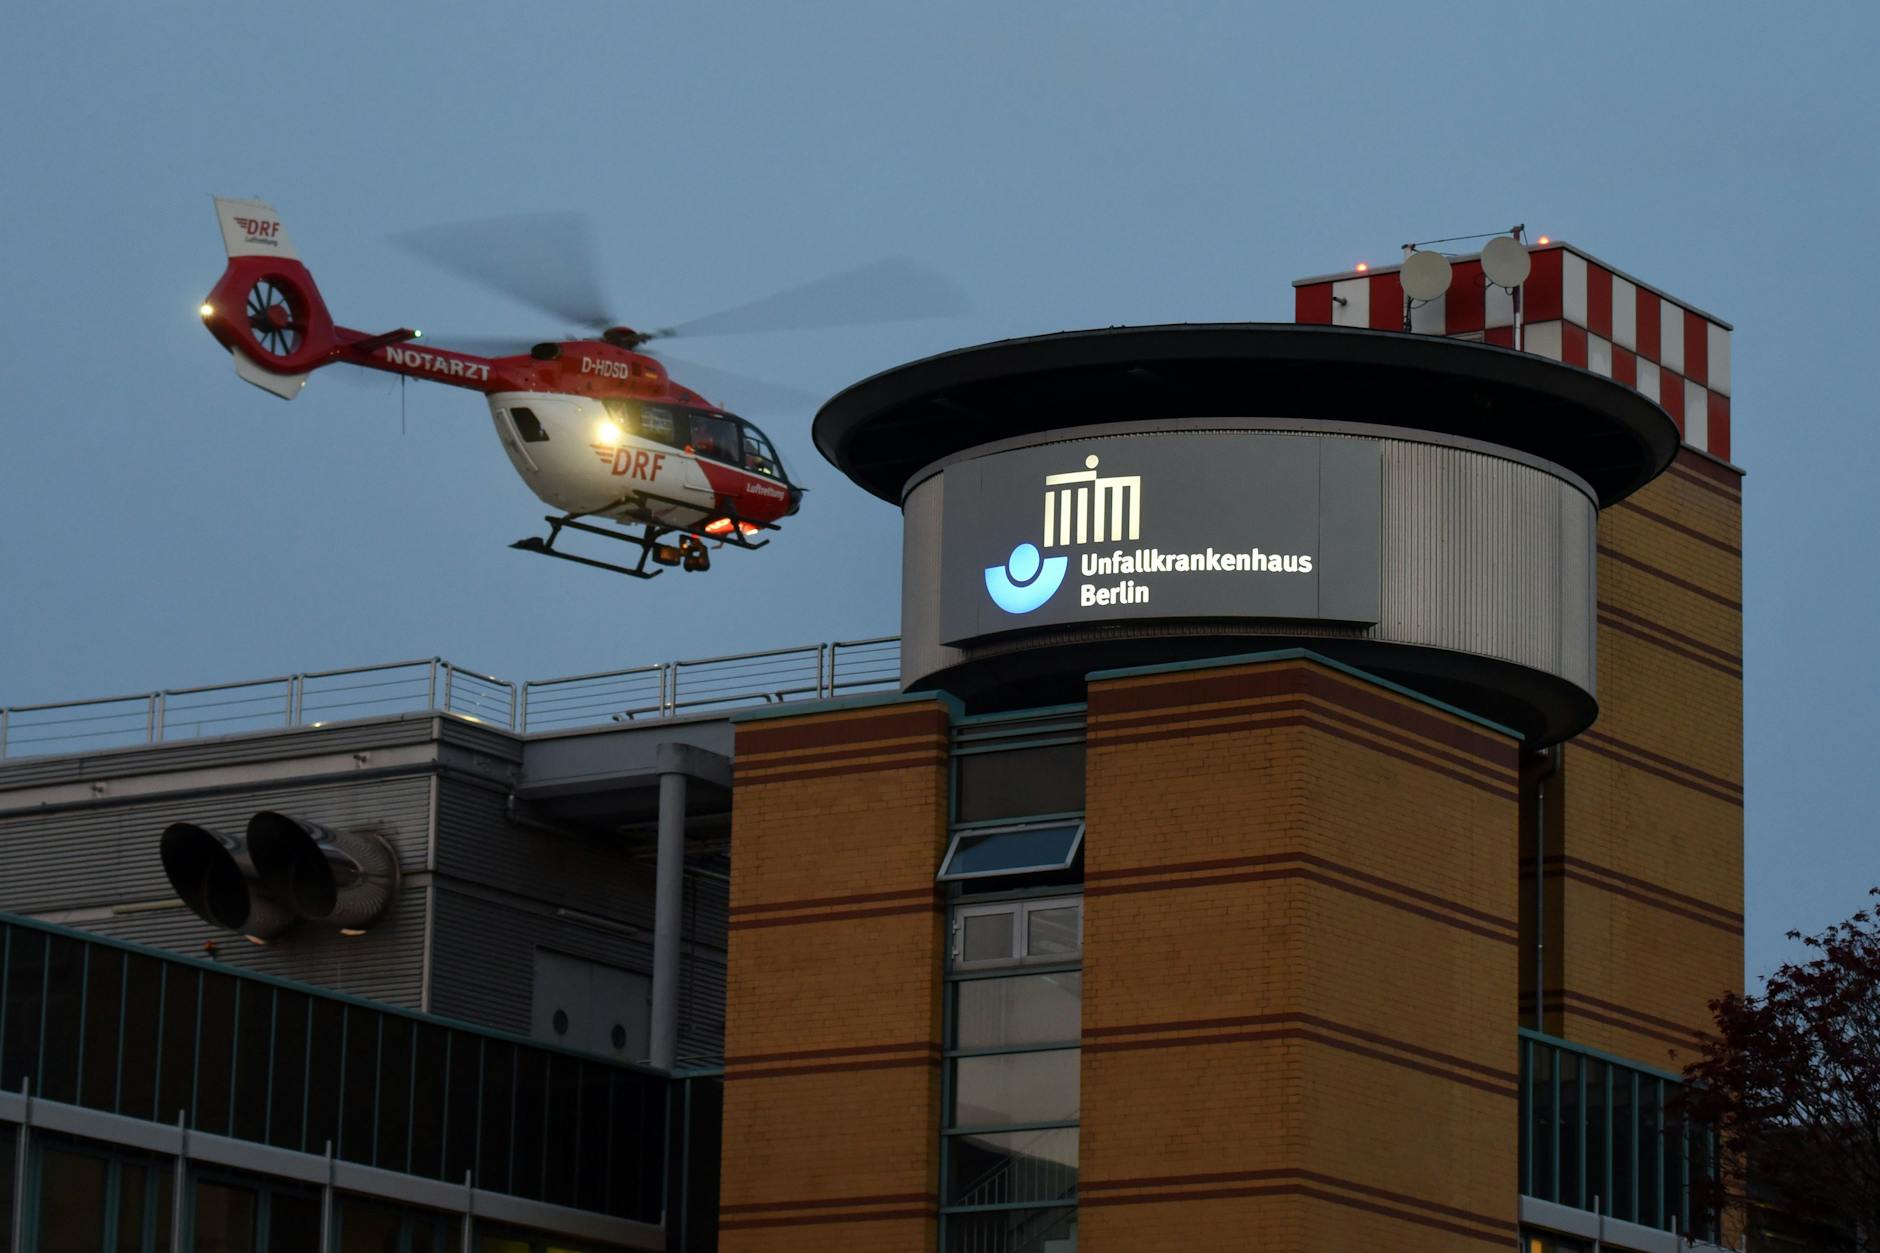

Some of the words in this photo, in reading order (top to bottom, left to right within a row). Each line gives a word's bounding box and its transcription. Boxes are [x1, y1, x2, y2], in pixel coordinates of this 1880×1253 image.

[247, 219, 280, 238] DRF
[385, 346, 490, 381] NOTARZT
[581, 356, 628, 379] D-HDSD
[611, 447, 666, 482] DRF
[1081, 547, 1313, 577] Unfallkrankenhaus
[1080, 580, 1150, 607] Berlin
